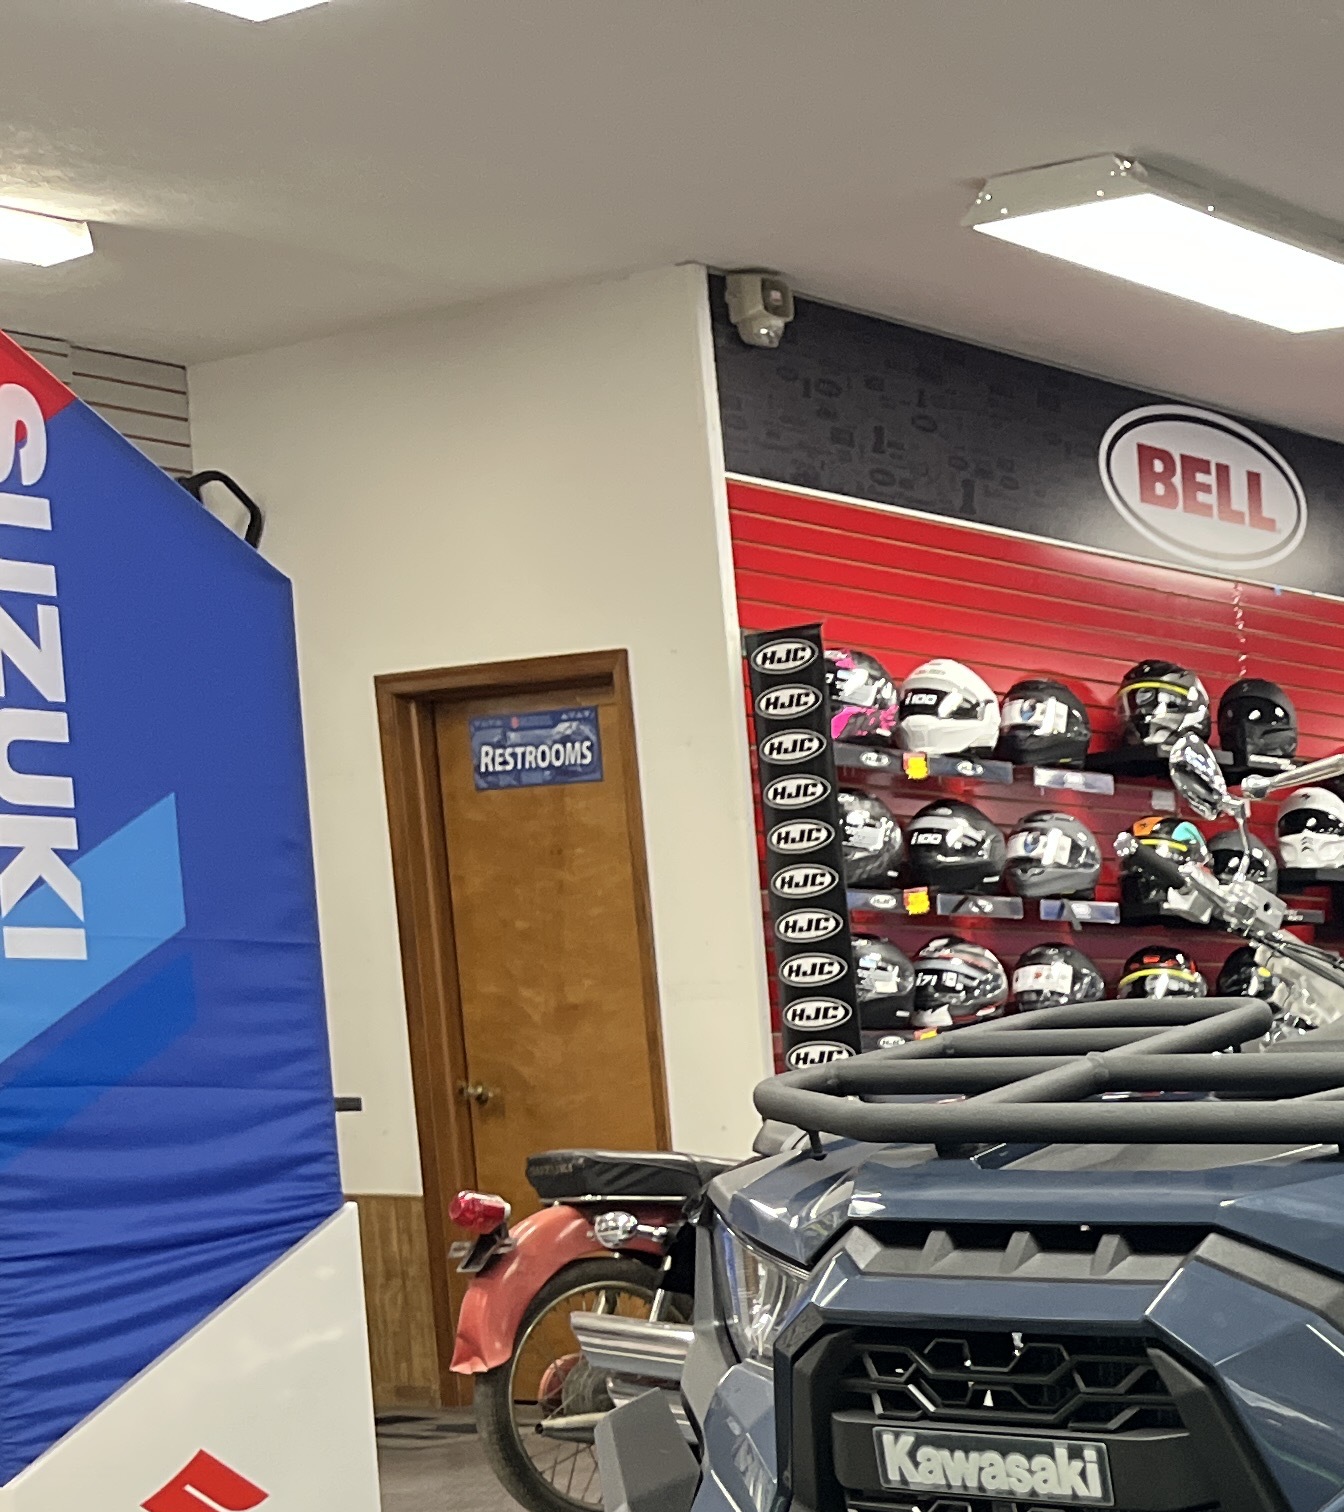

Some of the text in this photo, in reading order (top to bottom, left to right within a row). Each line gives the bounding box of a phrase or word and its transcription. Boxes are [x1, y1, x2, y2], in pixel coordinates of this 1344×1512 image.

[1136, 442, 1277, 533] BELL
[761, 646, 807, 666] HJC
[0, 383, 88, 961] SUZUKI
[765, 692, 811, 711] HJC
[769, 737, 814, 756] HJC
[480, 740, 592, 773] RESTROOMS
[772, 783, 818, 801] HJC
[776, 827, 822, 846] HJC
[780, 872, 827, 890] HJC
[784, 916, 830, 934] HJC
[788, 961, 835, 978] HJC
[791, 1005, 839, 1022] HJC
[881, 1431, 1103, 1498] Kawasaki
